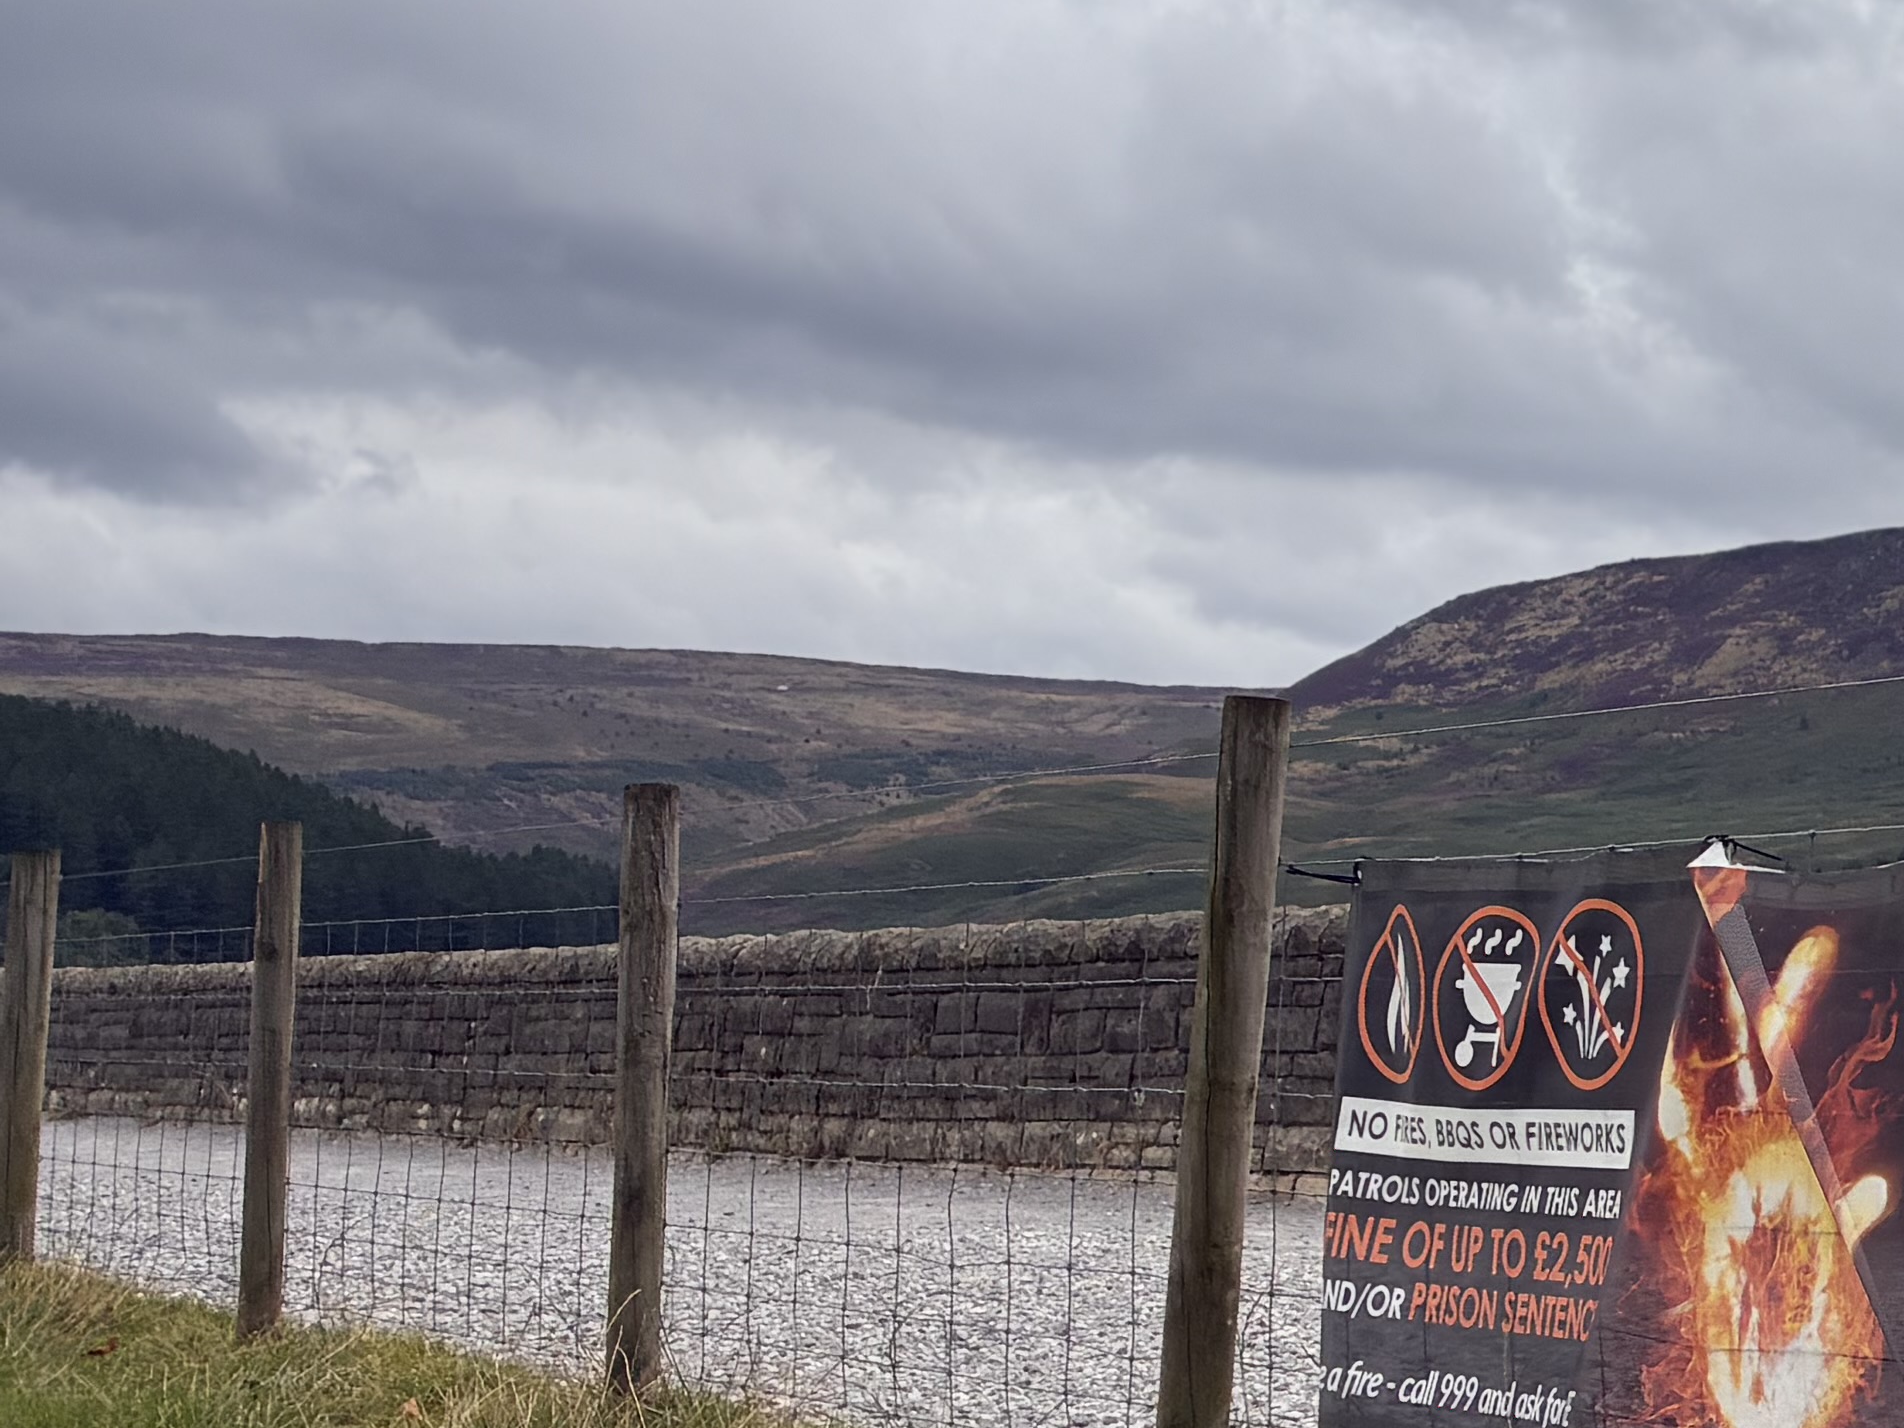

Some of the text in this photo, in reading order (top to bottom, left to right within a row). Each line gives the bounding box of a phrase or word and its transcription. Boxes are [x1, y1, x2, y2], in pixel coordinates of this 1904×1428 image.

[1348, 1109, 1388, 1140] NO
[1436, 1118, 1485, 1150] BBQS
[1489, 1121, 1521, 1151] OR
[1525, 1121, 1626, 1154] FIREWORKS
[1329, 1168, 1622, 1220] PATROLS OPERATING IN THIS AREA
[1323, 1211, 1397, 1264] FINE
[1402, 1220, 1446, 1269] OF
[1450, 1224, 1485, 1272] UP
[1491, 1228, 1527, 1278] TO
[1408, 1282, 1498, 1330] PRISON
[1327, 1367, 1343, 1392] a
[1341, 1360, 1384, 1399] fire
[1398, 1370, 1440, 1406] call
[1438, 1373, 1480, 1411] 999
[1478, 1381, 1517, 1418] and
[1514, 1384, 1545, 1423] ask
